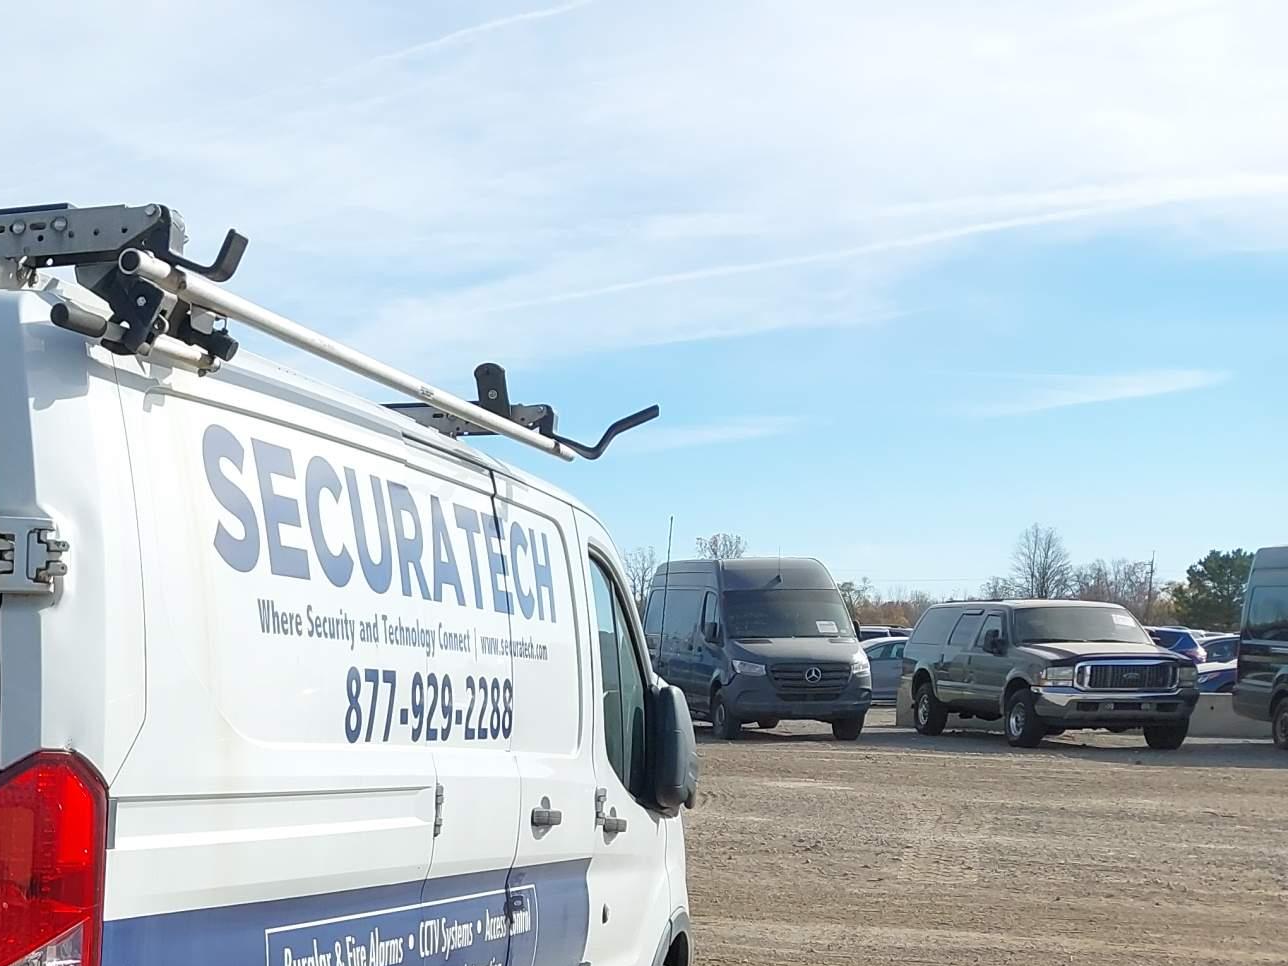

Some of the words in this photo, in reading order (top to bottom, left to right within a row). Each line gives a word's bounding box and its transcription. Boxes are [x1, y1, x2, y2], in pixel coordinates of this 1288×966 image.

[202, 423, 557, 623] SECURATECH
[257, 599, 303, 636] Where
[306, 604, 355, 650] Security
[360, 613, 380, 644] and
[382, 615, 436, 657] Technology
[438, 622, 471, 653] Connect
[480, 634, 548, 660] www.securatech.com
[345, 665, 513, 743] 877-929-2288
[419, 919, 440, 958] CCTV
[441, 917, 473, 960] Systems
[485, 908, 506, 941] Access
